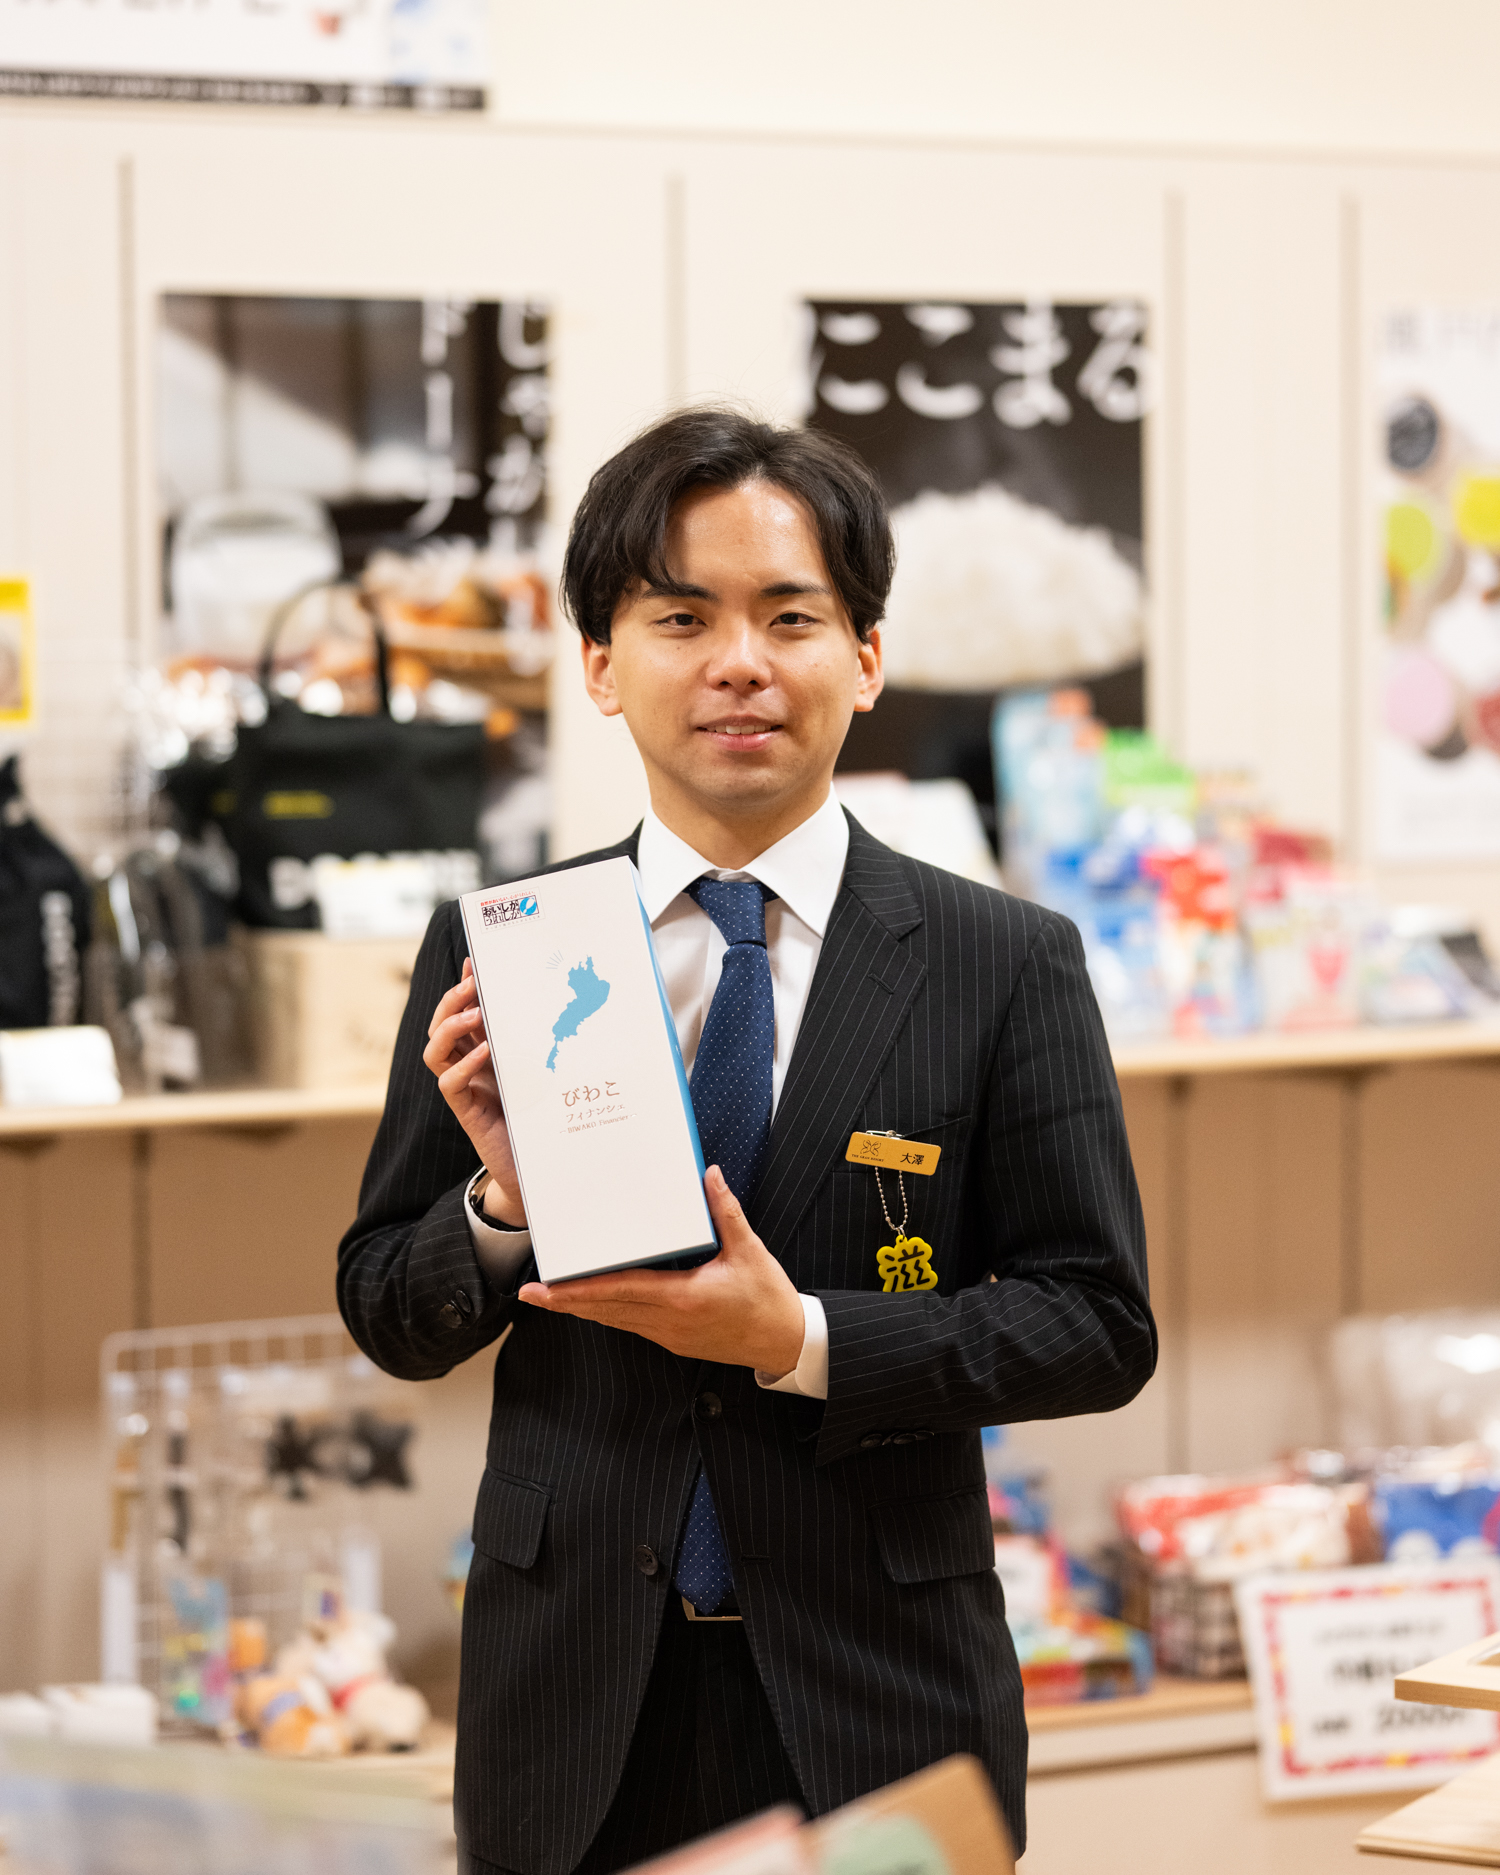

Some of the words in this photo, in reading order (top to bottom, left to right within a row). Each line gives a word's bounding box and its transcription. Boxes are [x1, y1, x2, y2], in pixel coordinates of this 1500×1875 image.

[561, 1080, 621, 1107] びわこ
[565, 1103, 626, 1124] フィナンシェ
[567, 1121, 597, 1134] BIWAKO
[598, 1114, 629, 1126] Financier
[899, 1152, 925, 1166] 大澤
[884, 1245, 931, 1293] 滋
